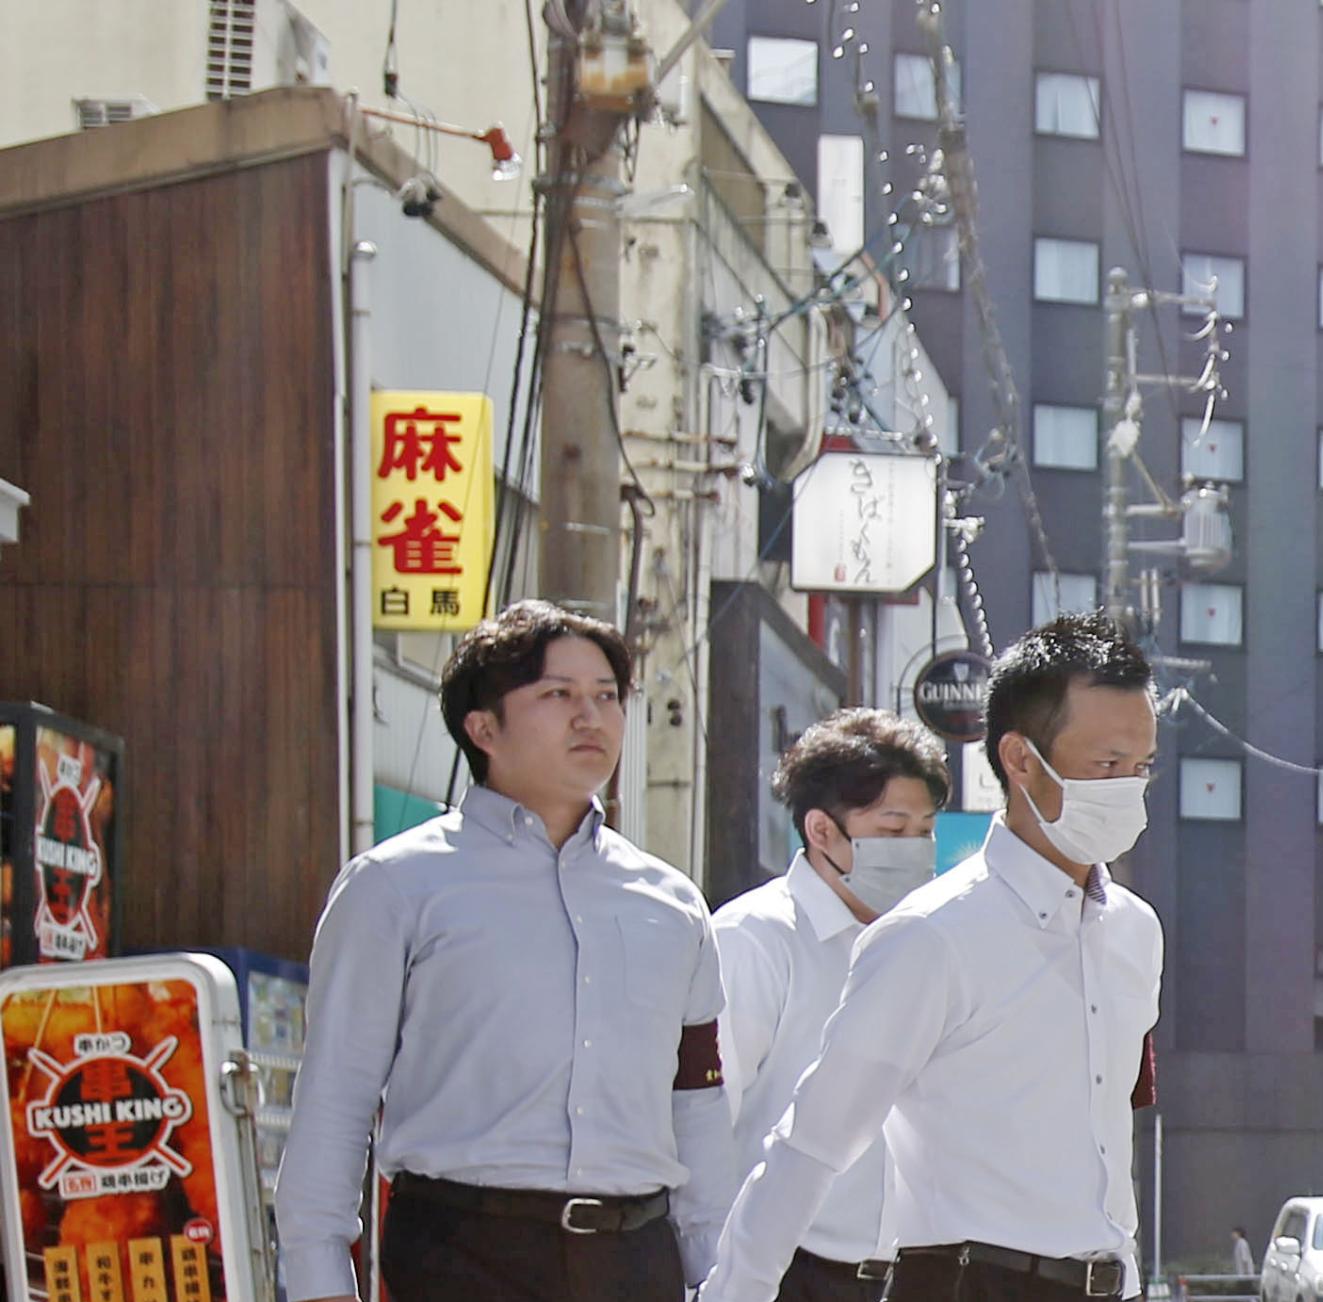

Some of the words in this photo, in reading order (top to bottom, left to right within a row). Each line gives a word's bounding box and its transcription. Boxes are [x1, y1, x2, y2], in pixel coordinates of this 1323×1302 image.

[377, 407, 462, 574] 麻雀
[381, 587, 459, 616] 白馬
[35, 1103, 111, 1129] KUSHI
[116, 1097, 184, 1124] KING
